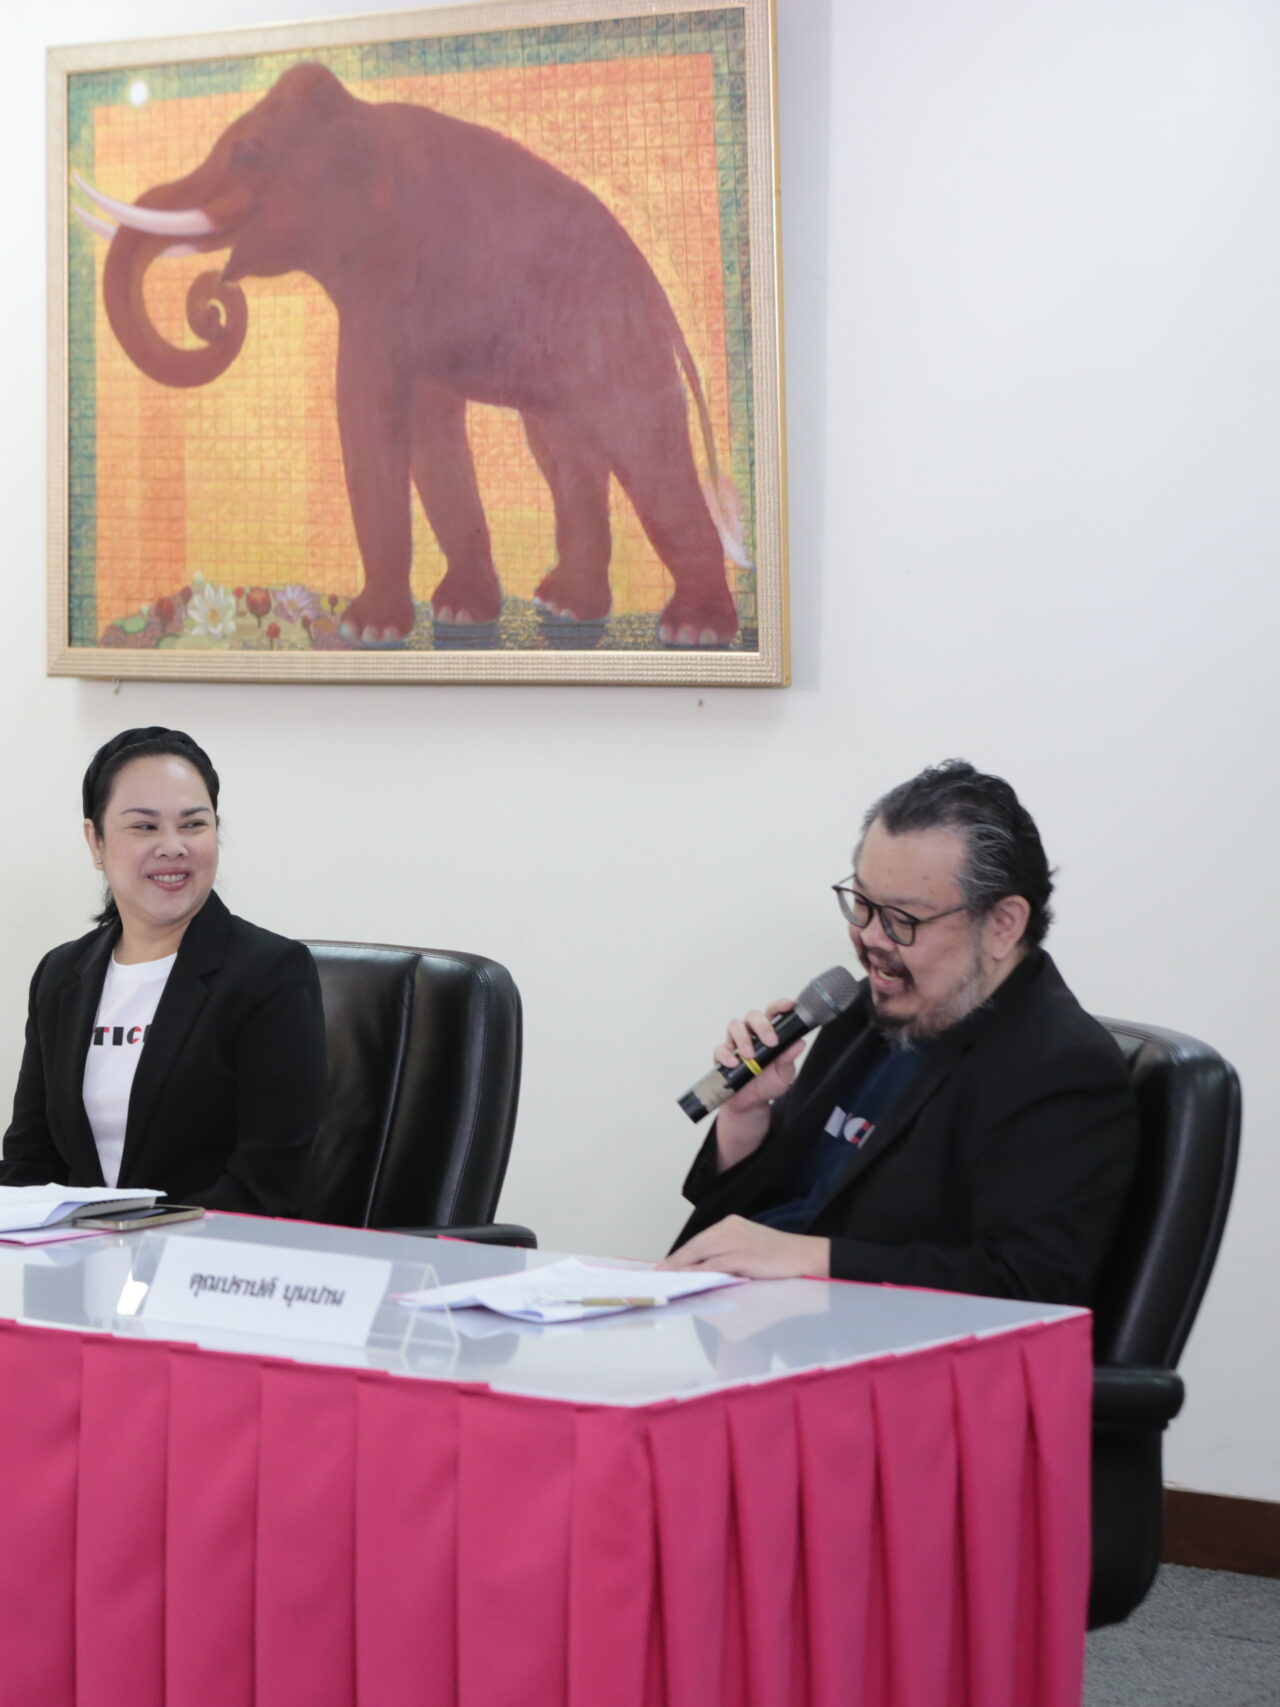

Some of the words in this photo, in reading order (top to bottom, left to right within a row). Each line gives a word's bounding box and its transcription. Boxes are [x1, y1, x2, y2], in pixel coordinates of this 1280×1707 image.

[189, 1272, 279, 1298] คุณปราปต์
[283, 1283, 346, 1308] บุนปาน
